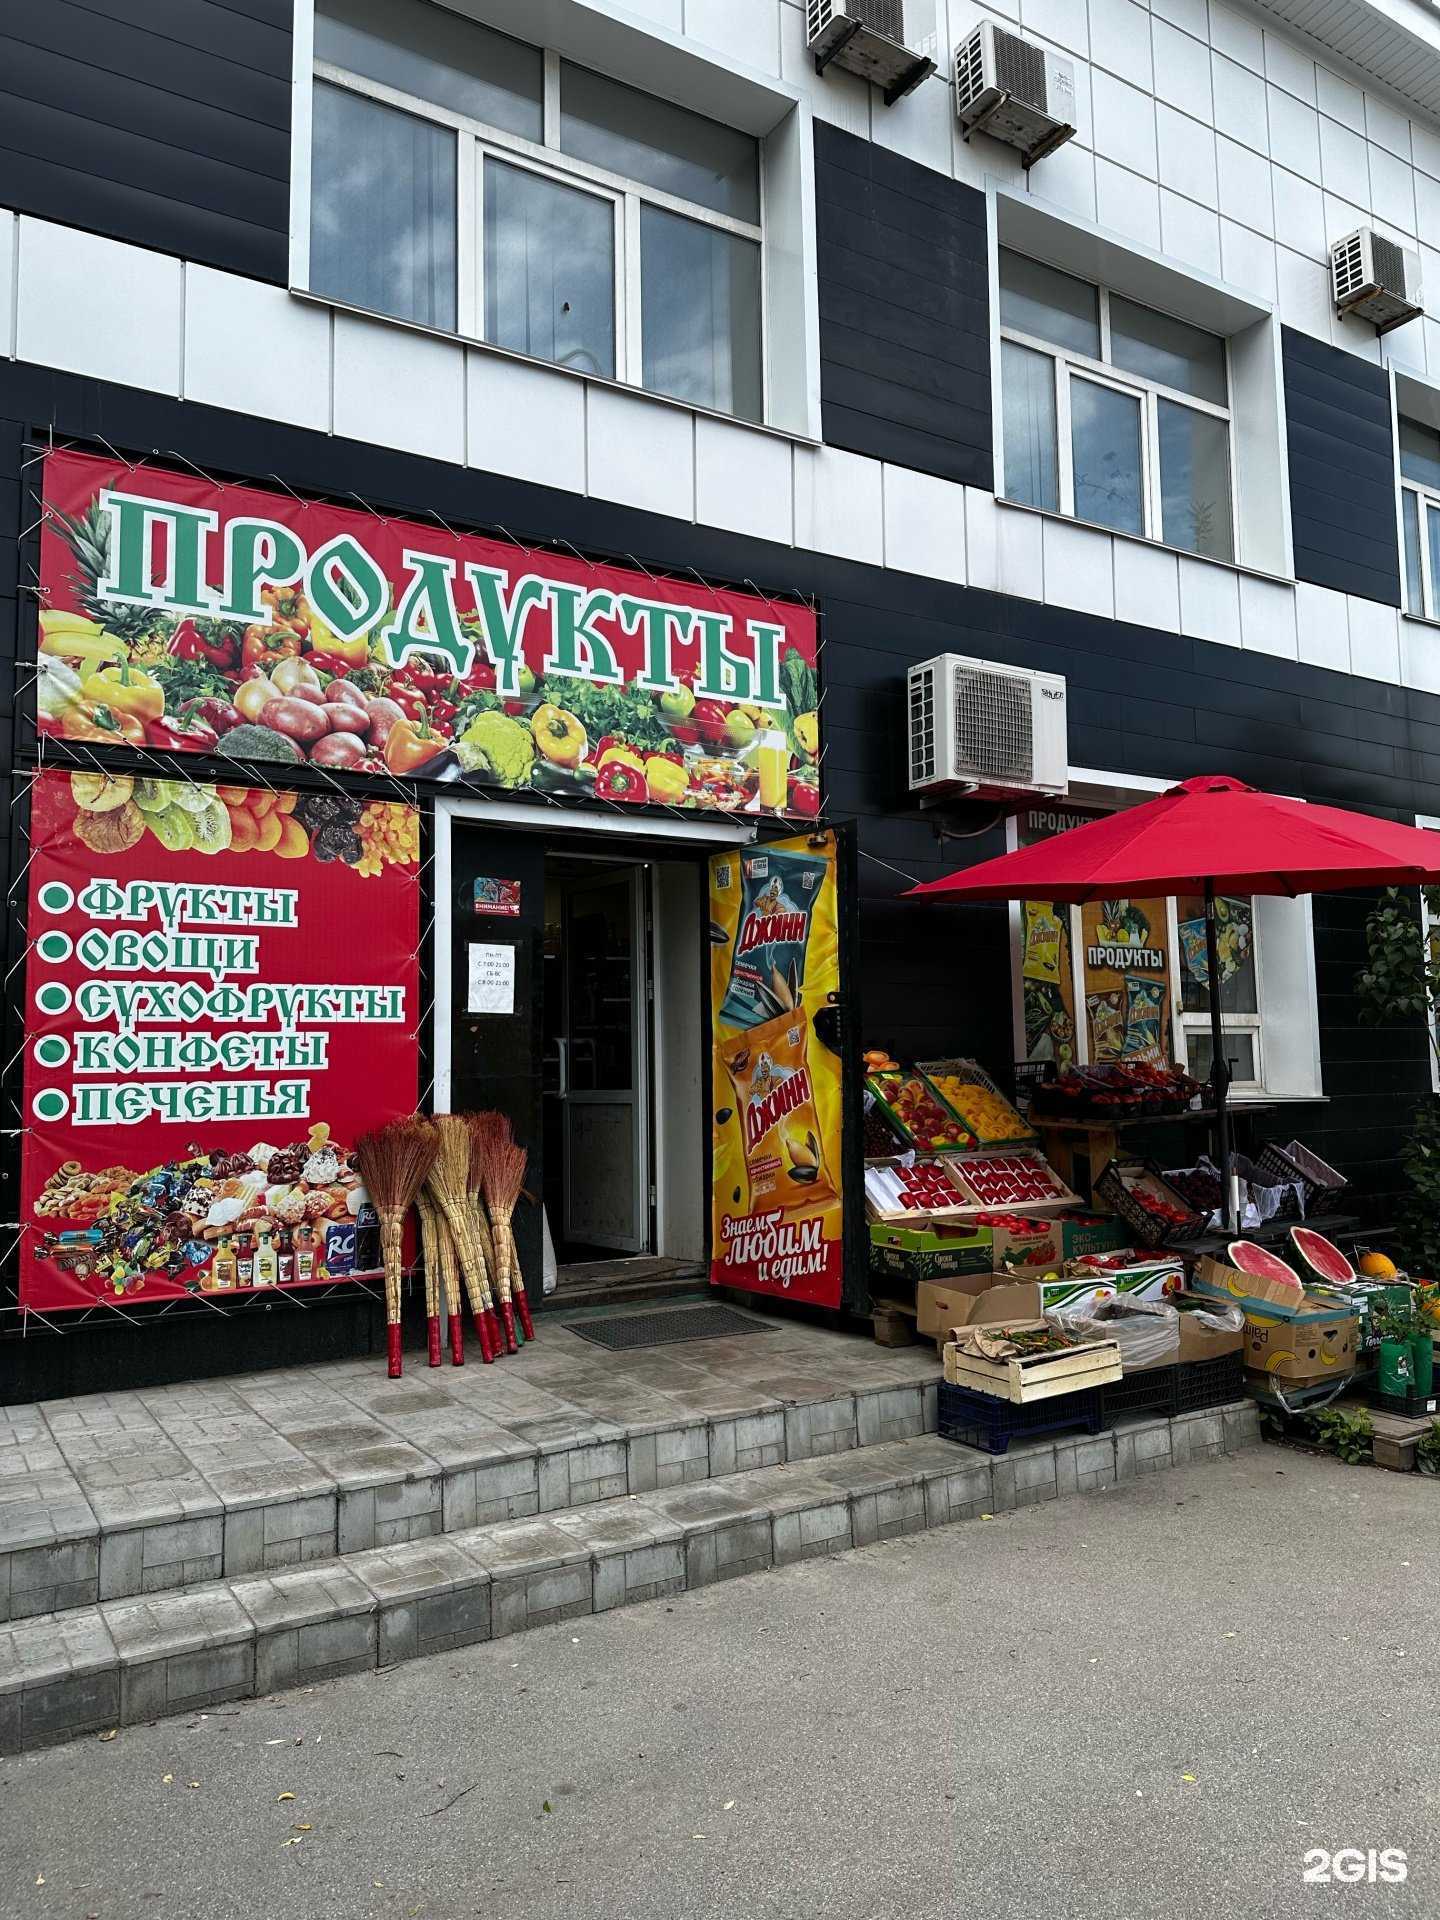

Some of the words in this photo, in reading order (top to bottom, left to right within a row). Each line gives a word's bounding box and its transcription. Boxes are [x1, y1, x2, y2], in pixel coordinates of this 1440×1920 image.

[97, 488, 786, 710] ПРОДУКТЫ
[1028, 810, 1097, 833] ПРОДУ
[78, 878, 298, 930] ФРУКТЫ
[76, 928, 259, 982] ОВОЩИ
[737, 911, 808, 956] ДЖИНН
[1087, 945, 1163, 968] ПРОДУКТЫ
[75, 980, 406, 1032] СУХОФРУКТЫ
[73, 1031, 329, 1073] КОНФЕТЫ
[72, 1079, 310, 1126] ПЕЧЕНЬЯ
[747, 1067, 811, 1156] ДЖИНН
